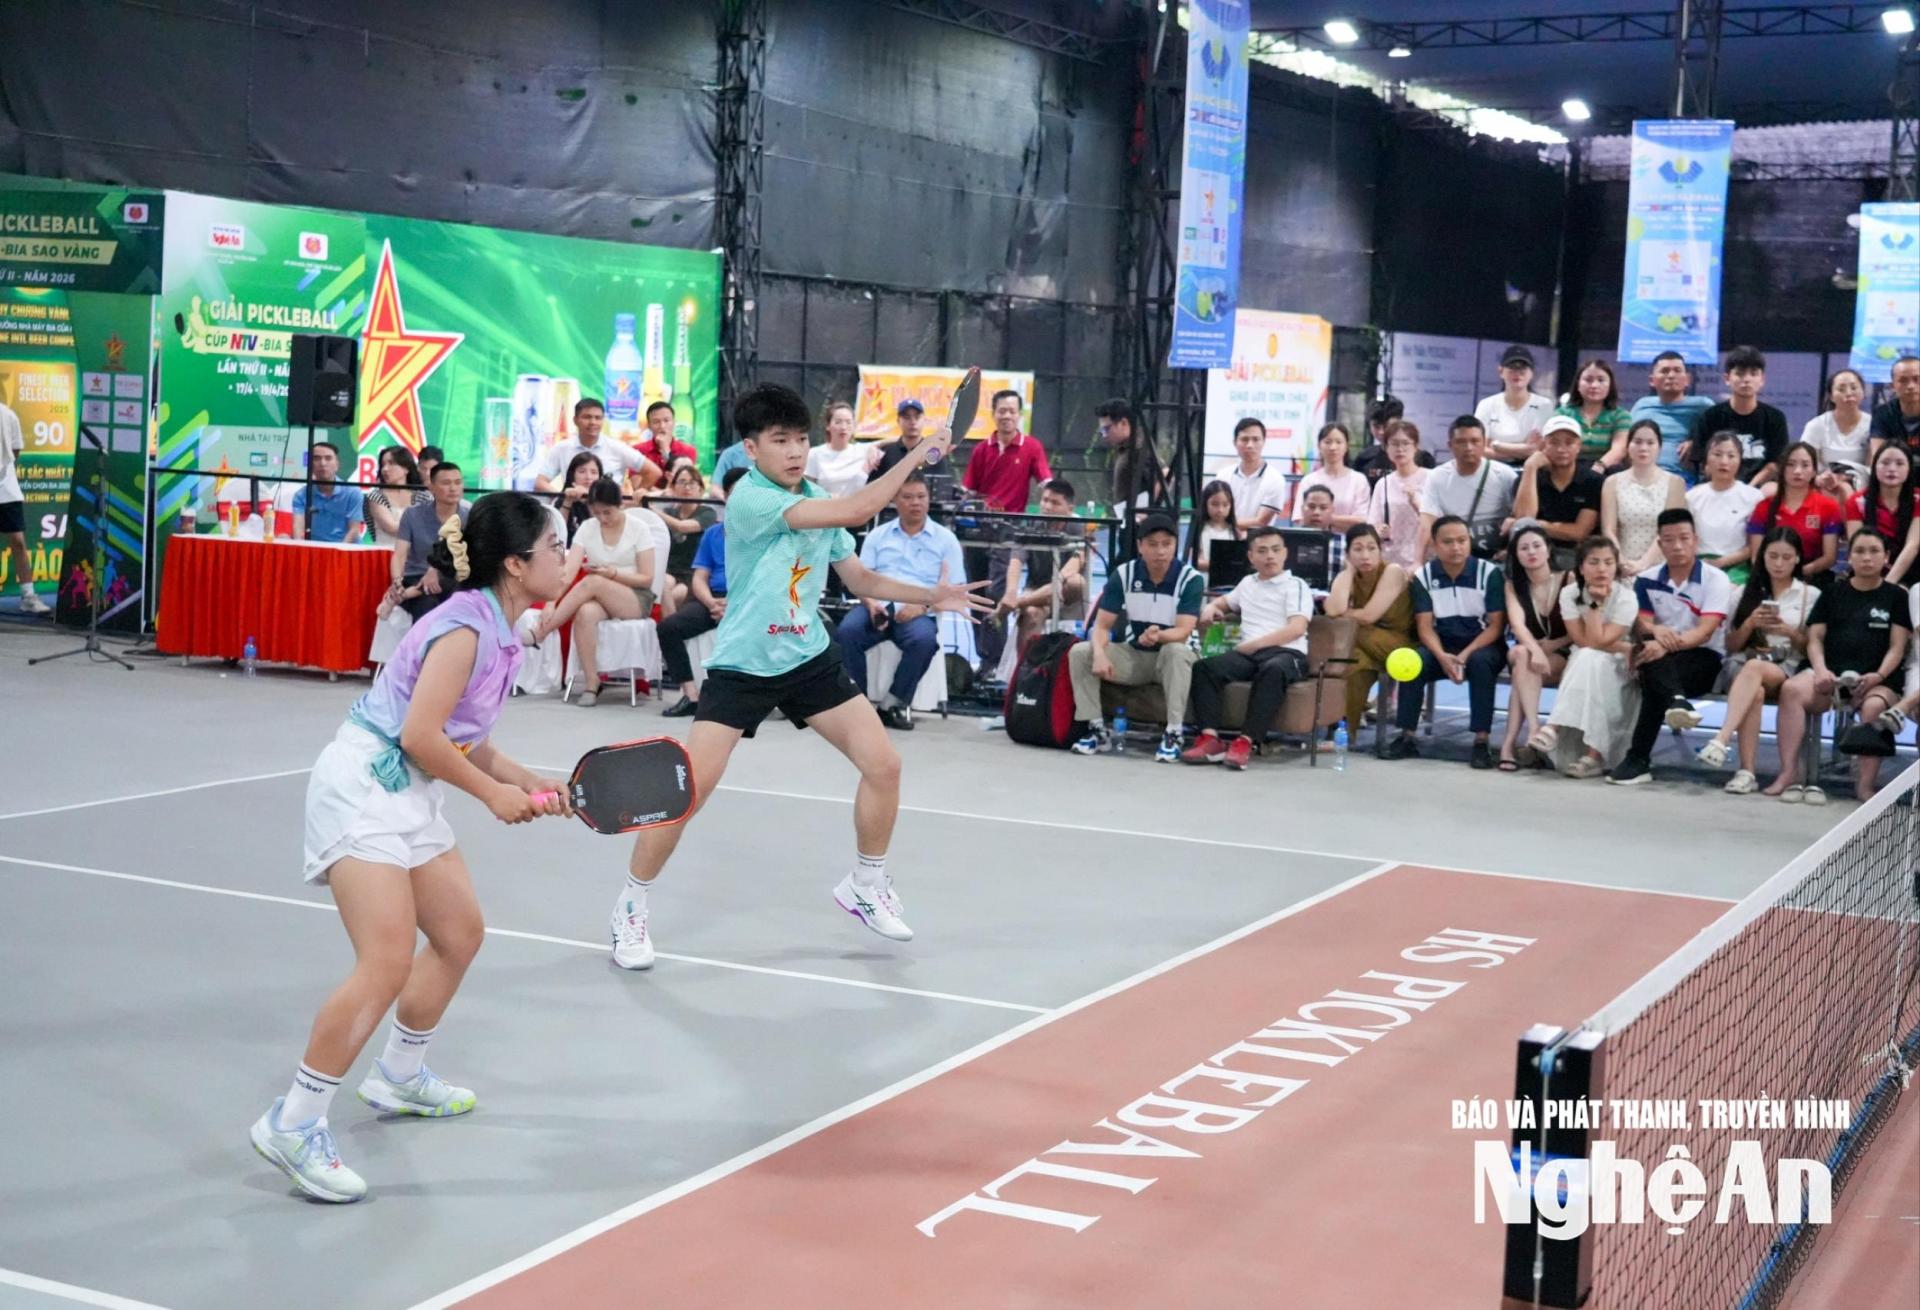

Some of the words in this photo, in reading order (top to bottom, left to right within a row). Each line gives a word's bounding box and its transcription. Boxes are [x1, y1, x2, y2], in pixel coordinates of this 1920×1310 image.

[31, 244, 58, 258] SAO
[63, 243, 100, 260] VÀNG
[24, 268, 48, 283] NĂM
[51, 272, 76, 284] 2026
[209, 294, 243, 321] GIẢI
[247, 303, 339, 330] PICKLEBALL
[205, 330, 228, 347] CÚP
[230, 333, 258, 351] NTV
[34, 421, 64, 446] 90
[1399, 926, 1538, 969] HS
[915, 968, 1469, 1237] PICKLEBALL
